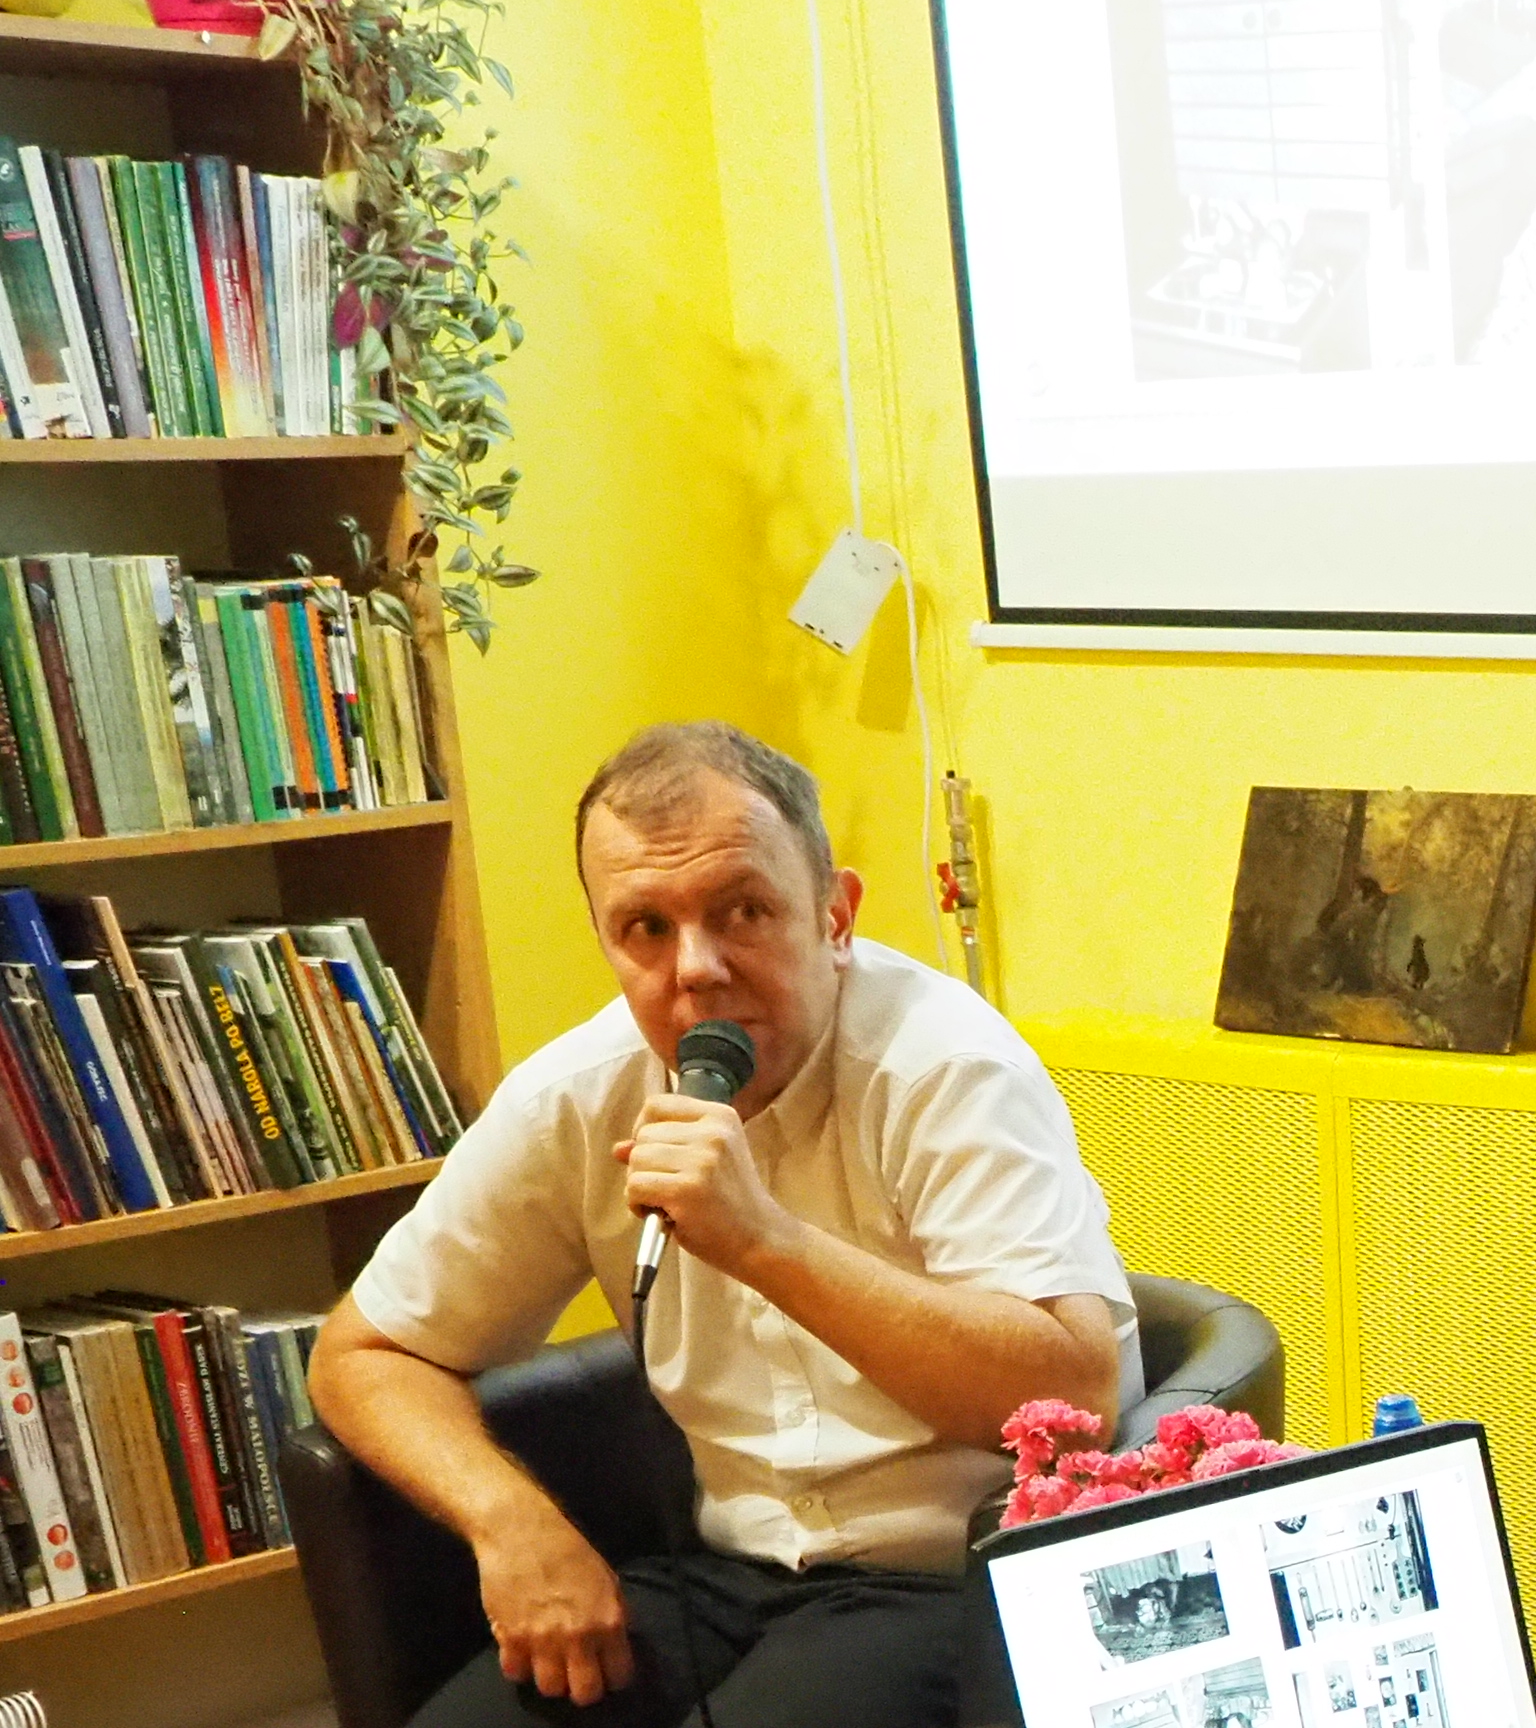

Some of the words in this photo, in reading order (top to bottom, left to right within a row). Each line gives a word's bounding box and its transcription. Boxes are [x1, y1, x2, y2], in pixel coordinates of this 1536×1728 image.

[225, 1025, 245, 1049] PO
[235, 1049, 271, 1115] NAROLA
[261, 1115, 281, 1140] OD
[242, 1393, 257, 1411] W
